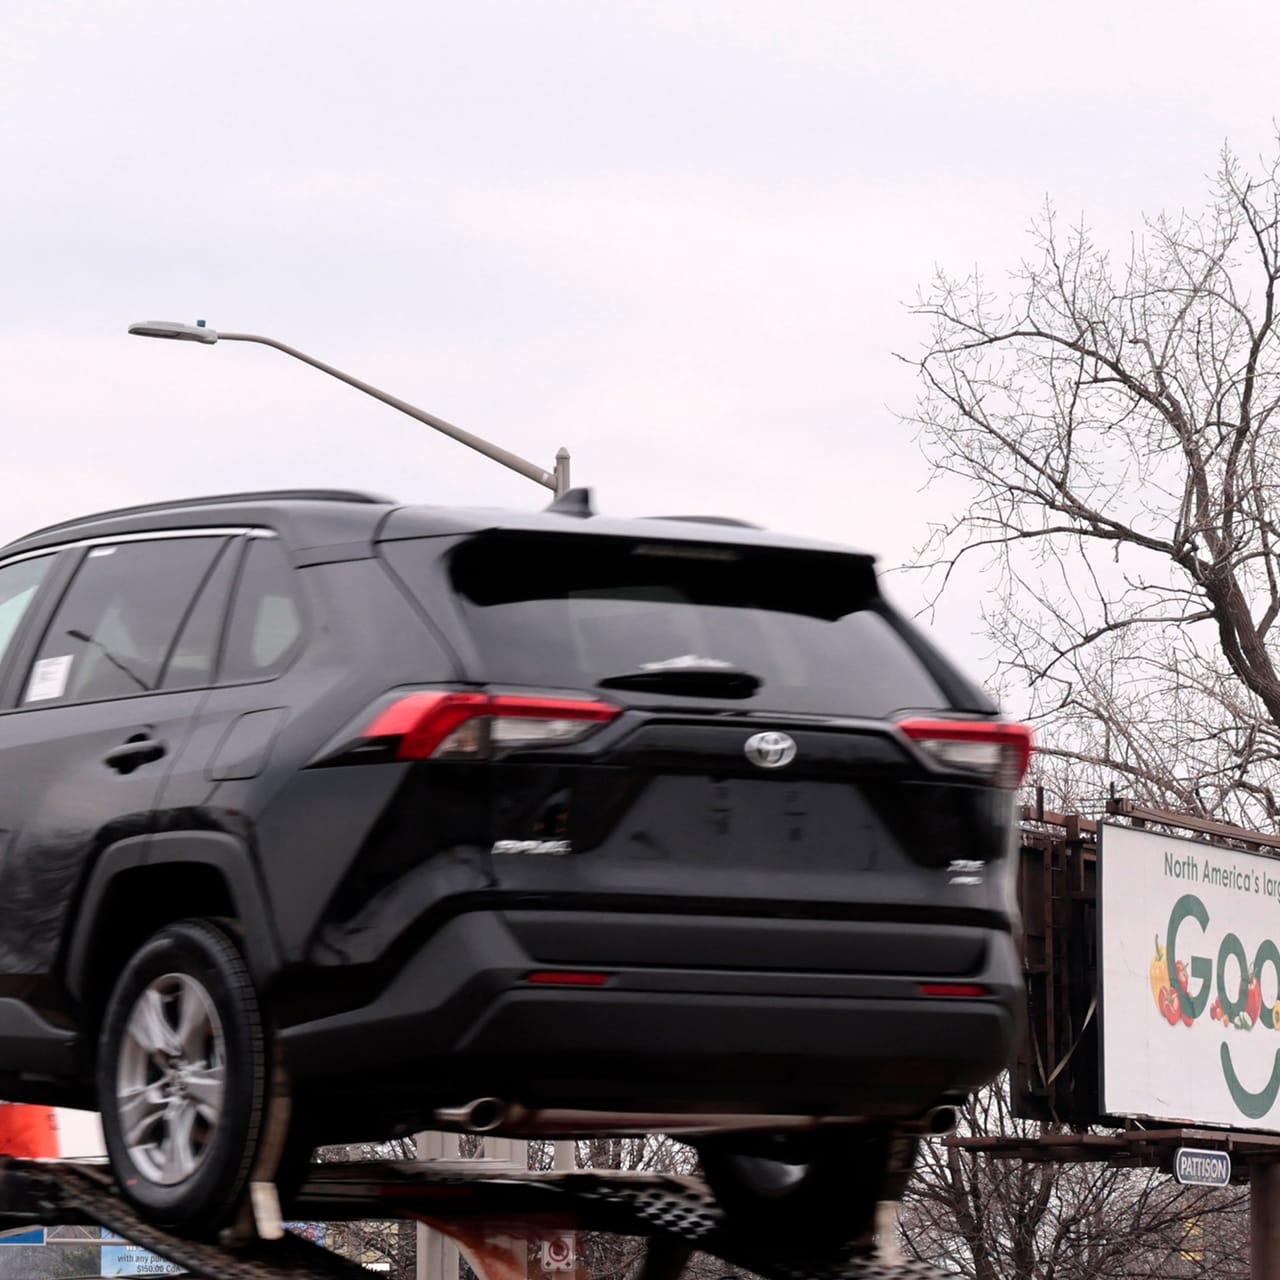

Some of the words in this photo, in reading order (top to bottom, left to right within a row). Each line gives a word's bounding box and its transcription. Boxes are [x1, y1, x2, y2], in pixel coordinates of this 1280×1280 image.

[1164, 852, 1199, 882] North
[1202, 859, 1260, 894] America's
[1181, 1155, 1227, 1180] PATTISON
[117, 1254, 133, 1263] with
[135, 1255, 149, 1263] any
